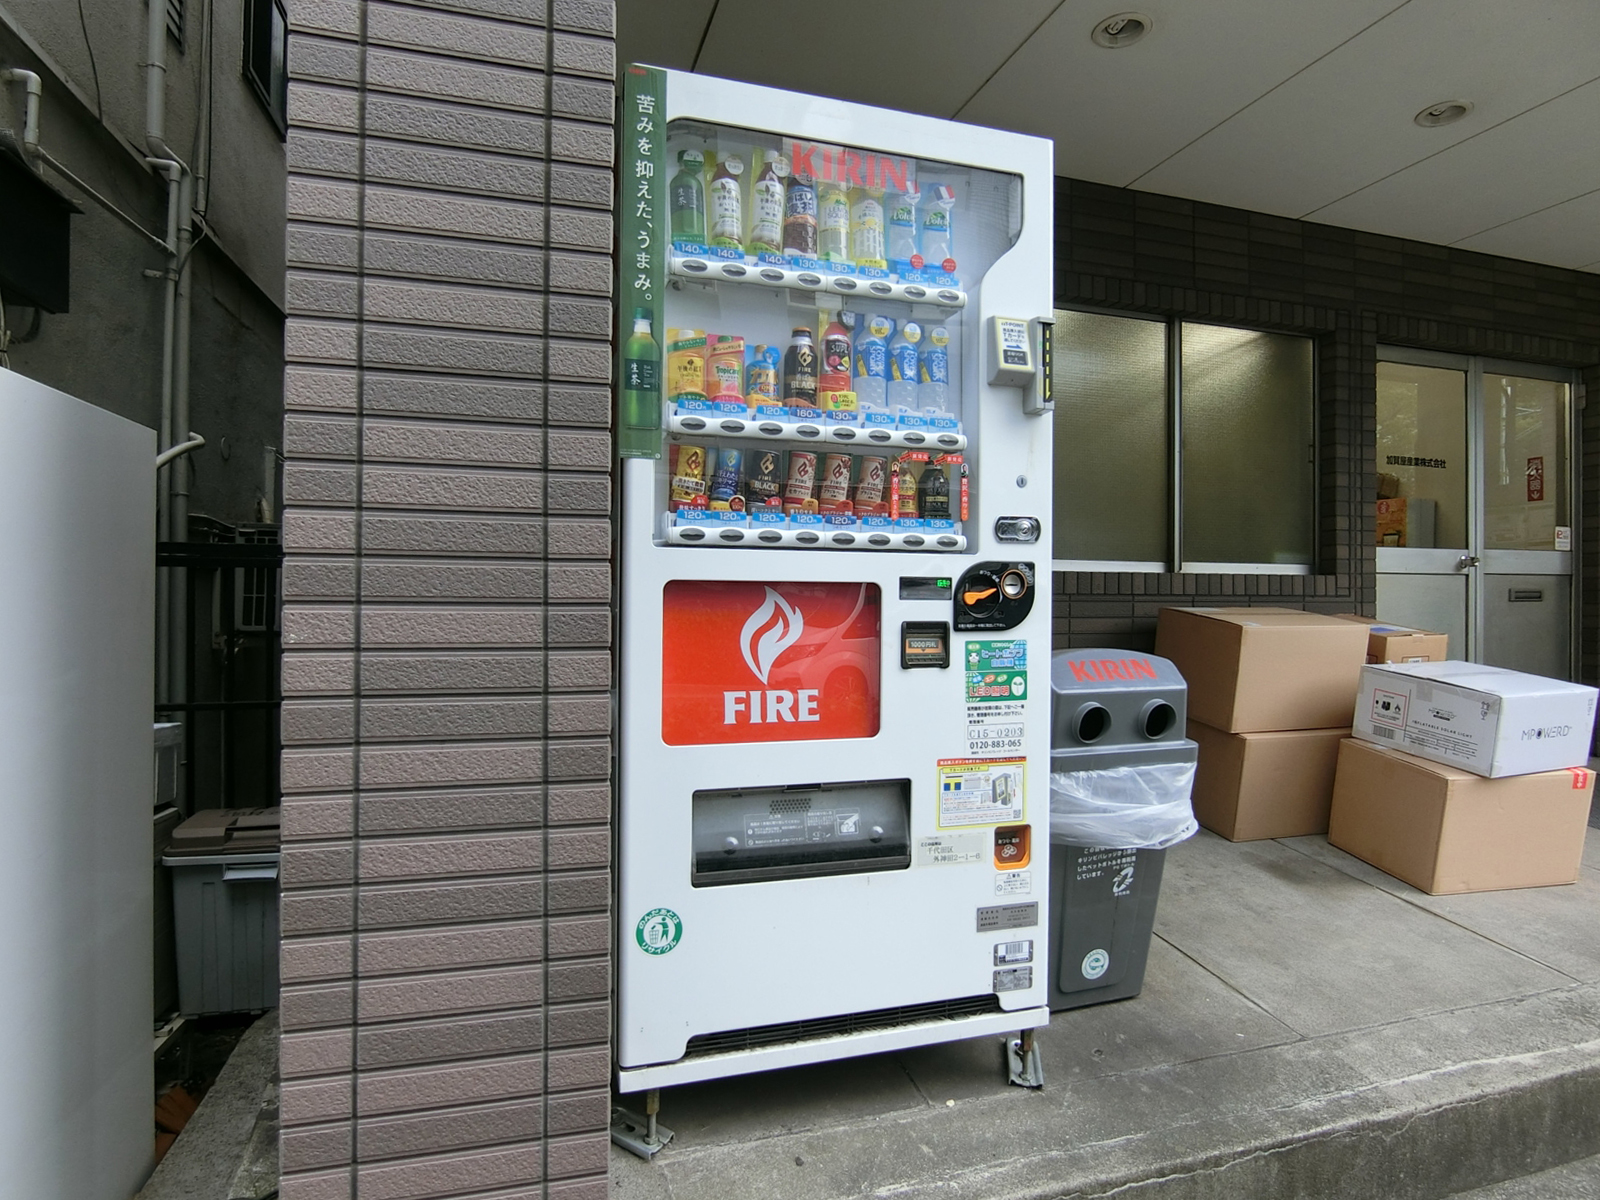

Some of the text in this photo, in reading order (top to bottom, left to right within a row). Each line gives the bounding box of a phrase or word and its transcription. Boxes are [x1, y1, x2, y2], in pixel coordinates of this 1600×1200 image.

[792, 142, 908, 193] KIRIN
[635, 94, 656, 301] 苦みを抑えた、うまみ。
[677, 187, 687, 206] 生茶
[630, 361, 641, 386] 生茶
[790, 381, 816, 389] BLACK
[1386, 455, 1447, 469] 加賀屋産業株式会社
[754, 480, 775, 491] BLACK
[981, 648, 1024, 659] ヒートポンプ
[1067, 658, 1158, 683] KIRIN
[969, 685, 1010, 697] LED照明
[723, 688, 820, 725] FIRE
[1440, 726, 1457, 735] SOLAR
[1457, 731, 1474, 739] LIGHT
[1521, 724, 1570, 741] MPOWERD
[969, 739, 1021, 750] 0120-883-065
[926, 846, 954, 855] 千代田区
[1076, 870, 1105, 881] しています。
[641, 939, 677, 954] リサイクル
